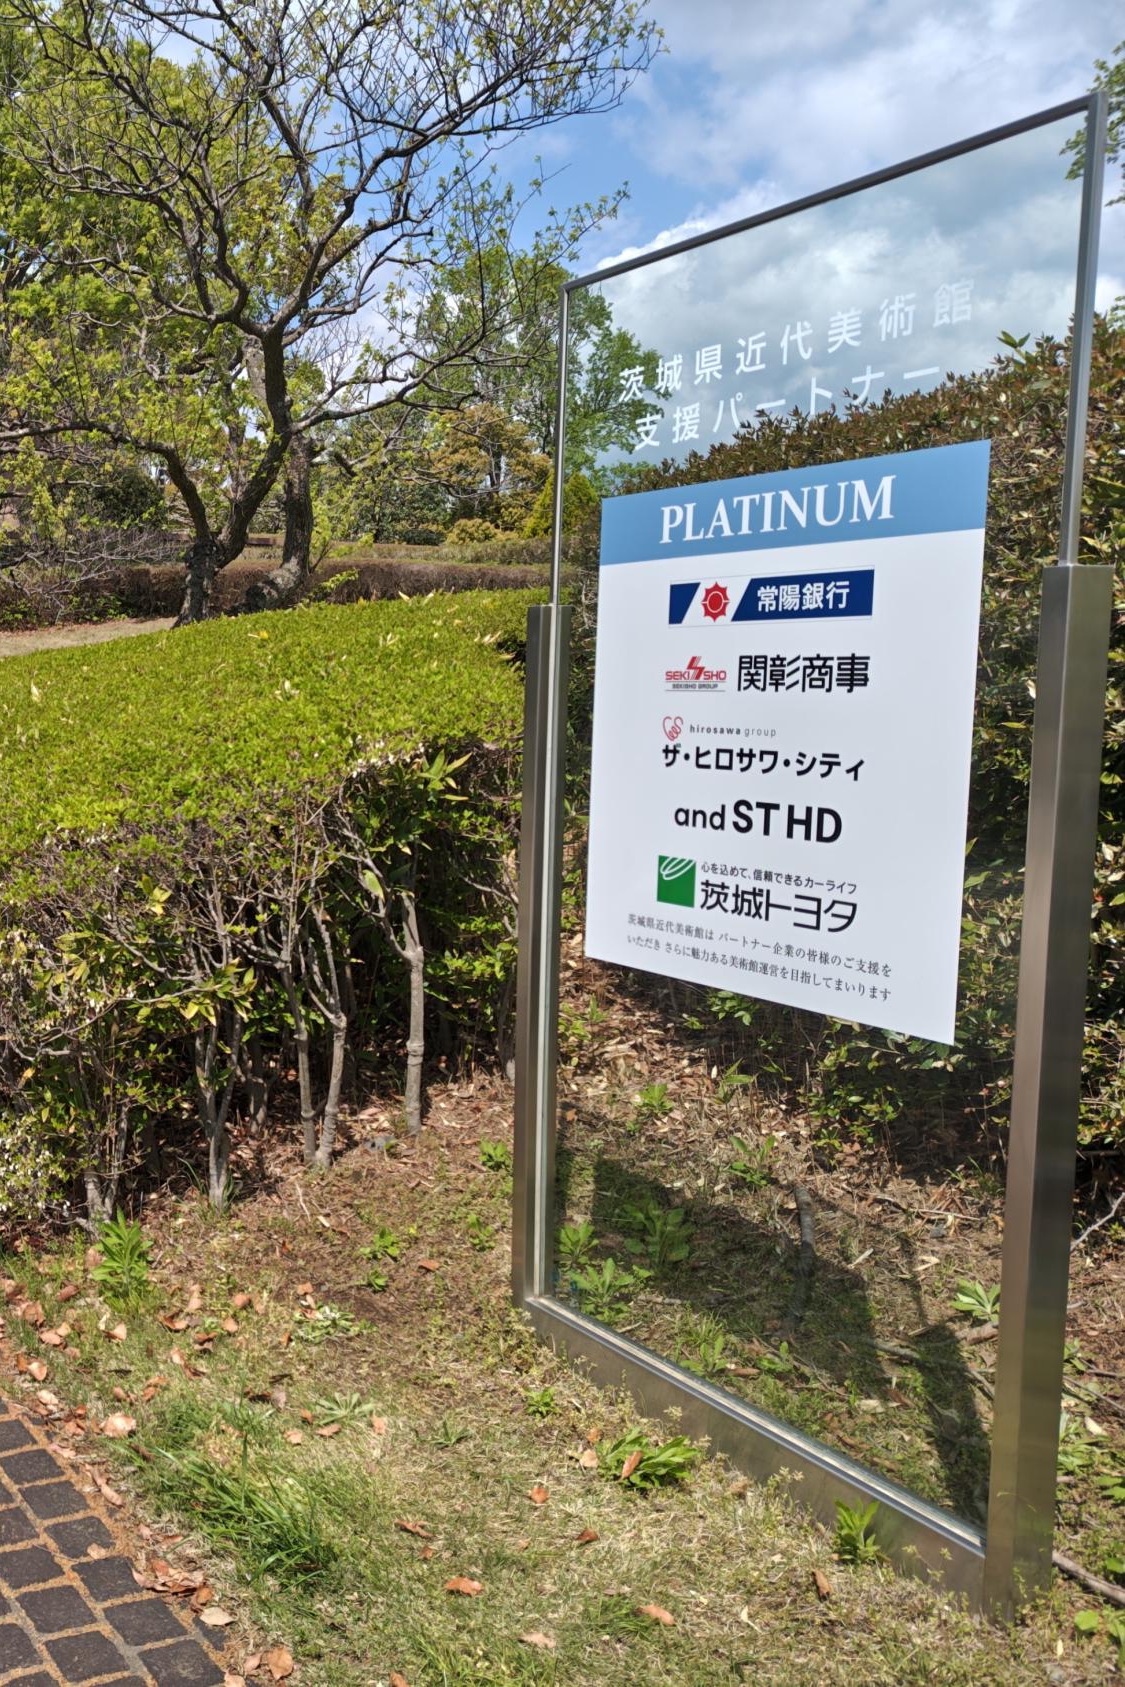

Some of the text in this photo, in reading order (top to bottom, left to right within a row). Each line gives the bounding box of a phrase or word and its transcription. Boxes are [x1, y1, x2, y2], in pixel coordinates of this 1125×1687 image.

[618, 278, 975, 403] 茨城県近代美術館
[634, 365, 941, 451] 支援パートナー
[659, 474, 897, 544] PLATINUM
[756, 580, 850, 613] 常陽銀行
[737, 653, 871, 694] 関彰商事
[689, 724, 777, 738] hirosawa group
[662, 743, 865, 782] ザ・ヒロサワ・シティ
[700, 861, 858, 895] 心を込めて、信頼できるカーライフ
[700, 878, 858, 933] 茨城トヨタ
